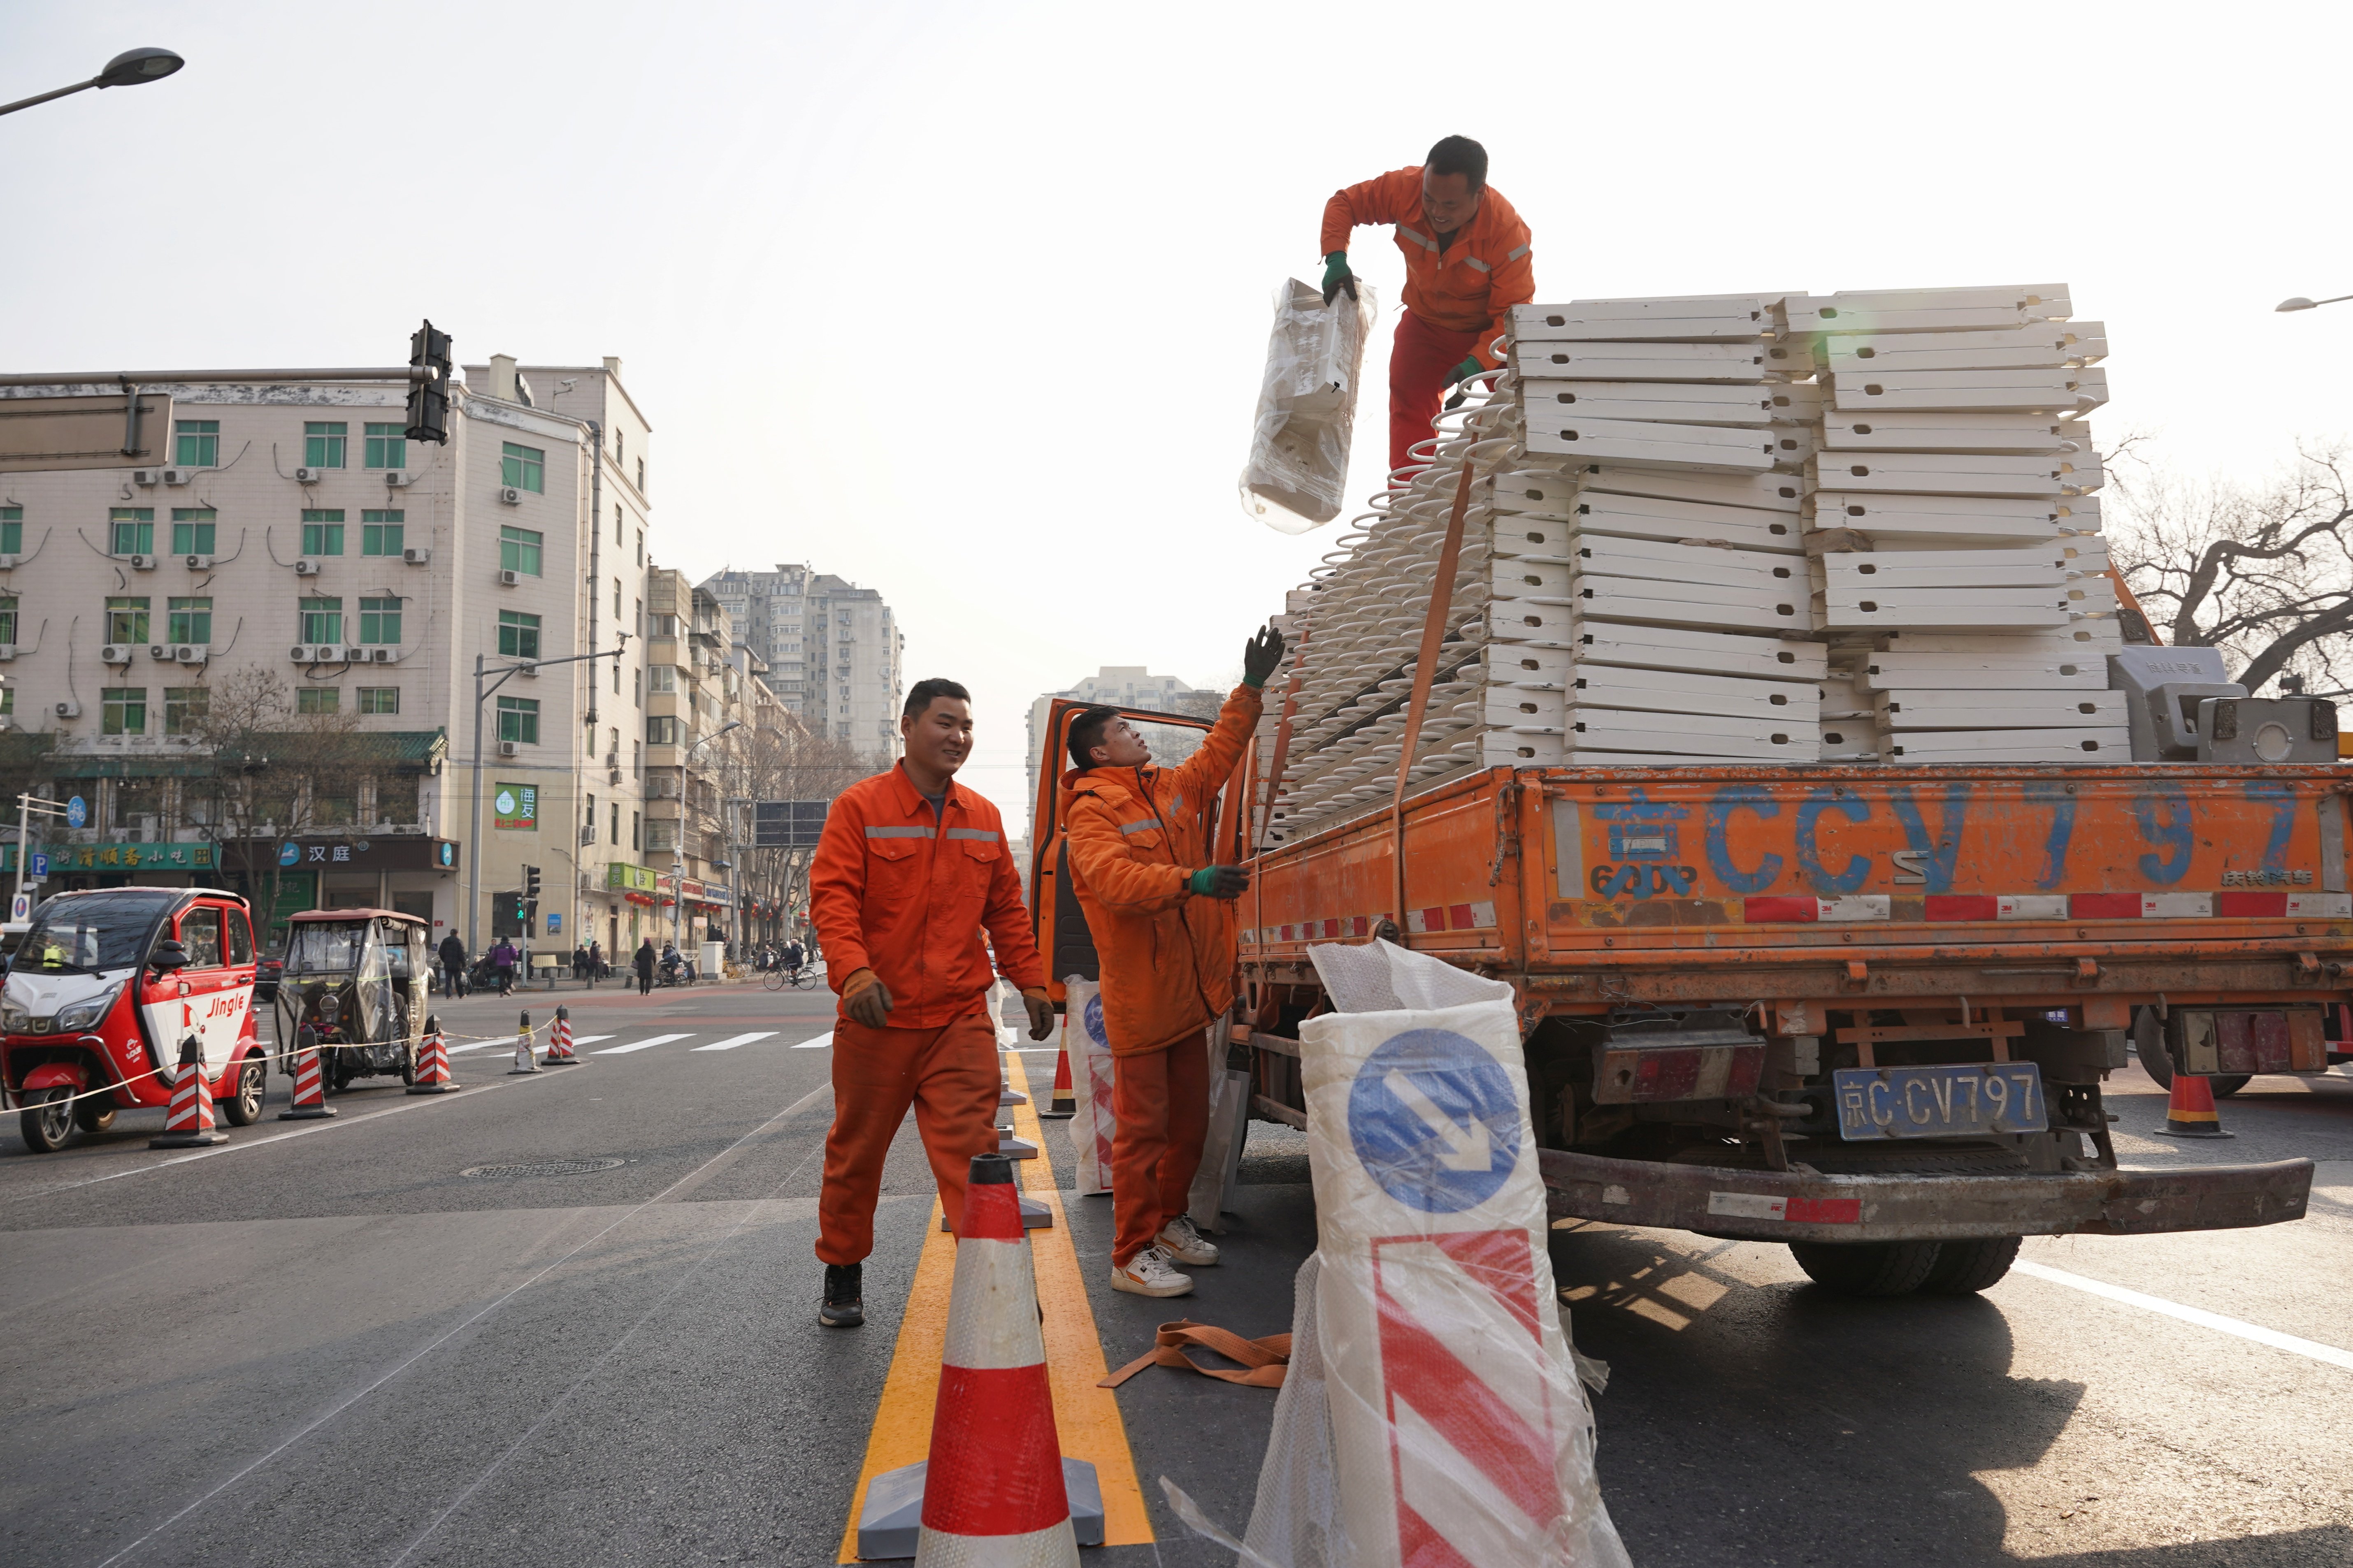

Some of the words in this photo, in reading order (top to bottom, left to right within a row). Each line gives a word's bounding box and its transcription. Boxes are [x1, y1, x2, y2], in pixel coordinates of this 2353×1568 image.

[520, 788, 534, 818] 海友
[1592, 779, 2297, 901] 京CCV797
[309, 845, 350, 862] 汉庭
[36, 856, 46, 873] P
[2221, 870, 2313, 886] 庆铃汽车
[207, 993, 244, 1018] Jingle
